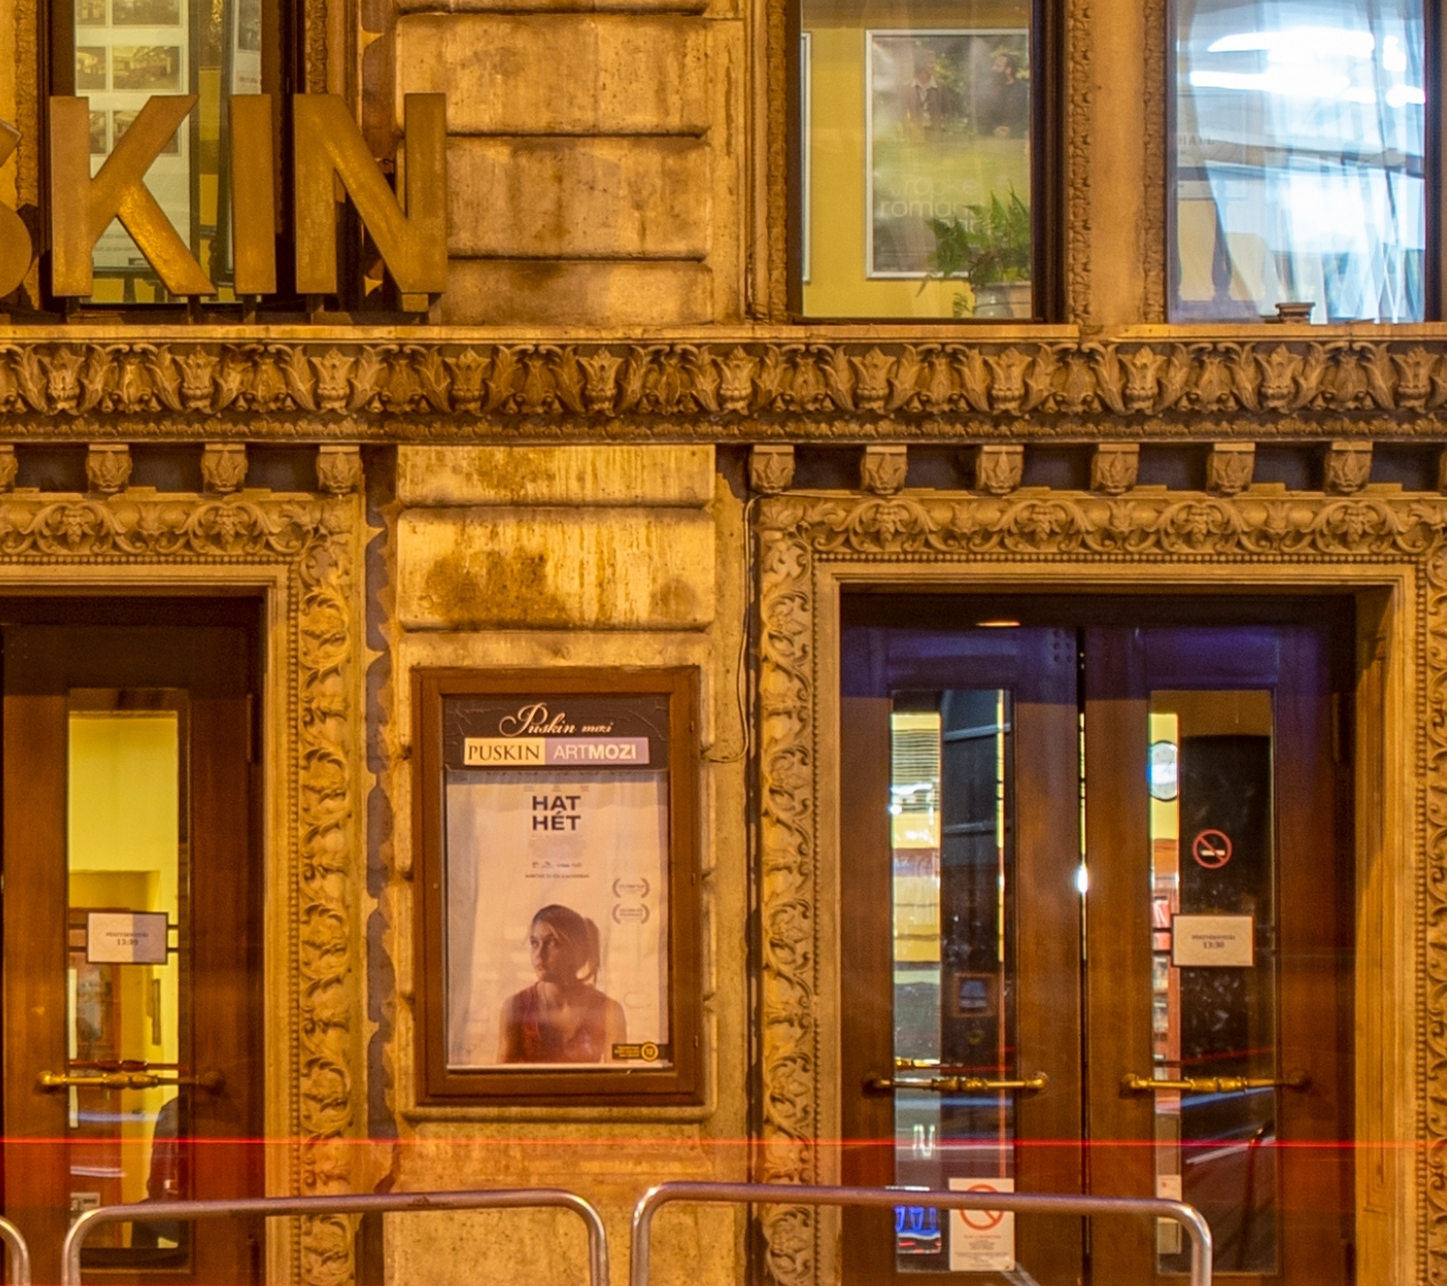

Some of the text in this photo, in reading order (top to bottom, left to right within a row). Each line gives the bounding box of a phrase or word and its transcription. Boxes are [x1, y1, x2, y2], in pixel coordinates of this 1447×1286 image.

[499, 702, 614, 737] Puskin mozi
[467, 743, 637, 761] PUSKIN ARTMOZI
[532, 795, 581, 811] HAT
[532, 811, 581, 831] HÉT
